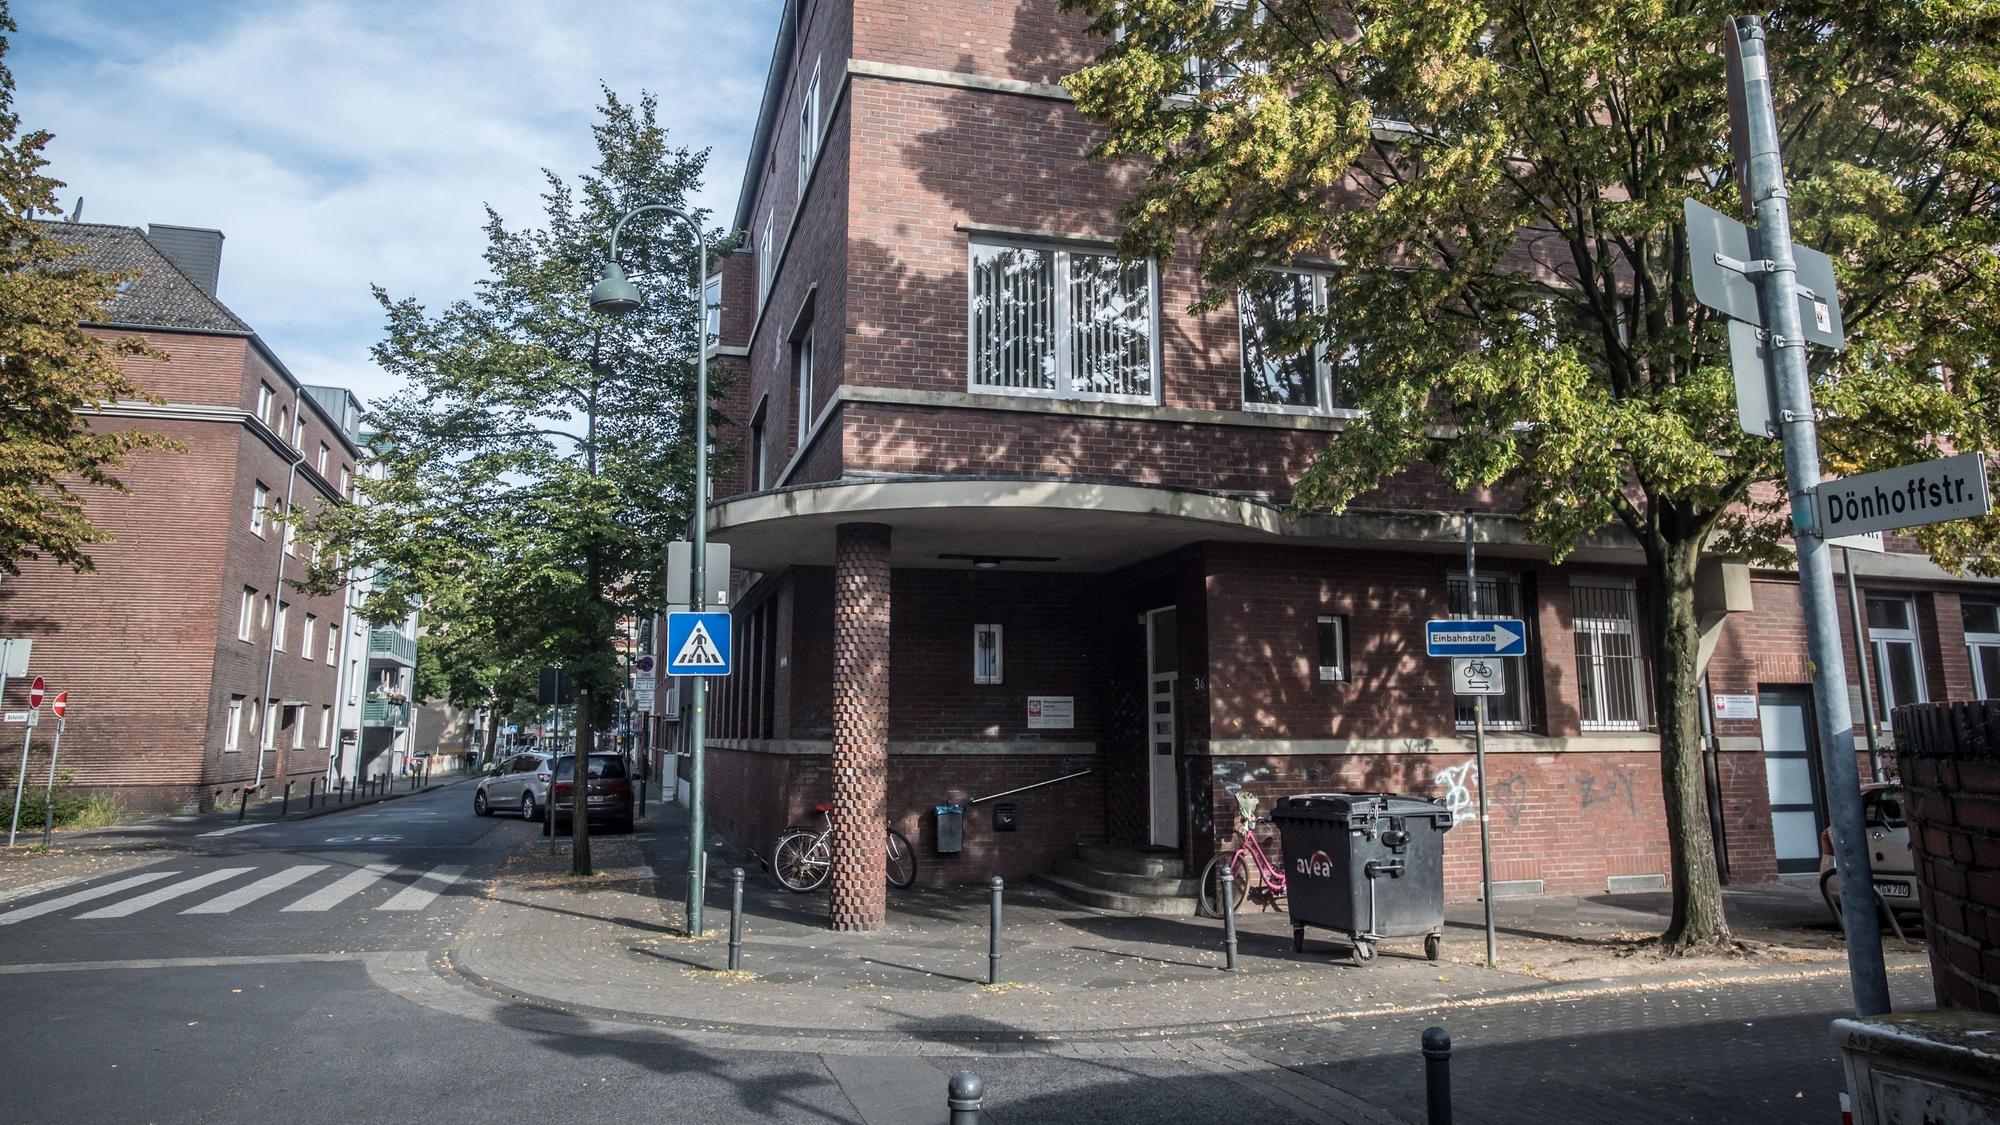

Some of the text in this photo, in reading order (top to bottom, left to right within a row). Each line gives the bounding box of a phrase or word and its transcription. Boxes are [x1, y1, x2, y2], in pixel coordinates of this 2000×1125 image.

[1827, 474, 1974, 524] Dönhoffstr.
[1432, 633, 1497, 644] Einbahnstraße
[1194, 678, 1205, 690] 36
[1296, 854, 1331, 878] avea
